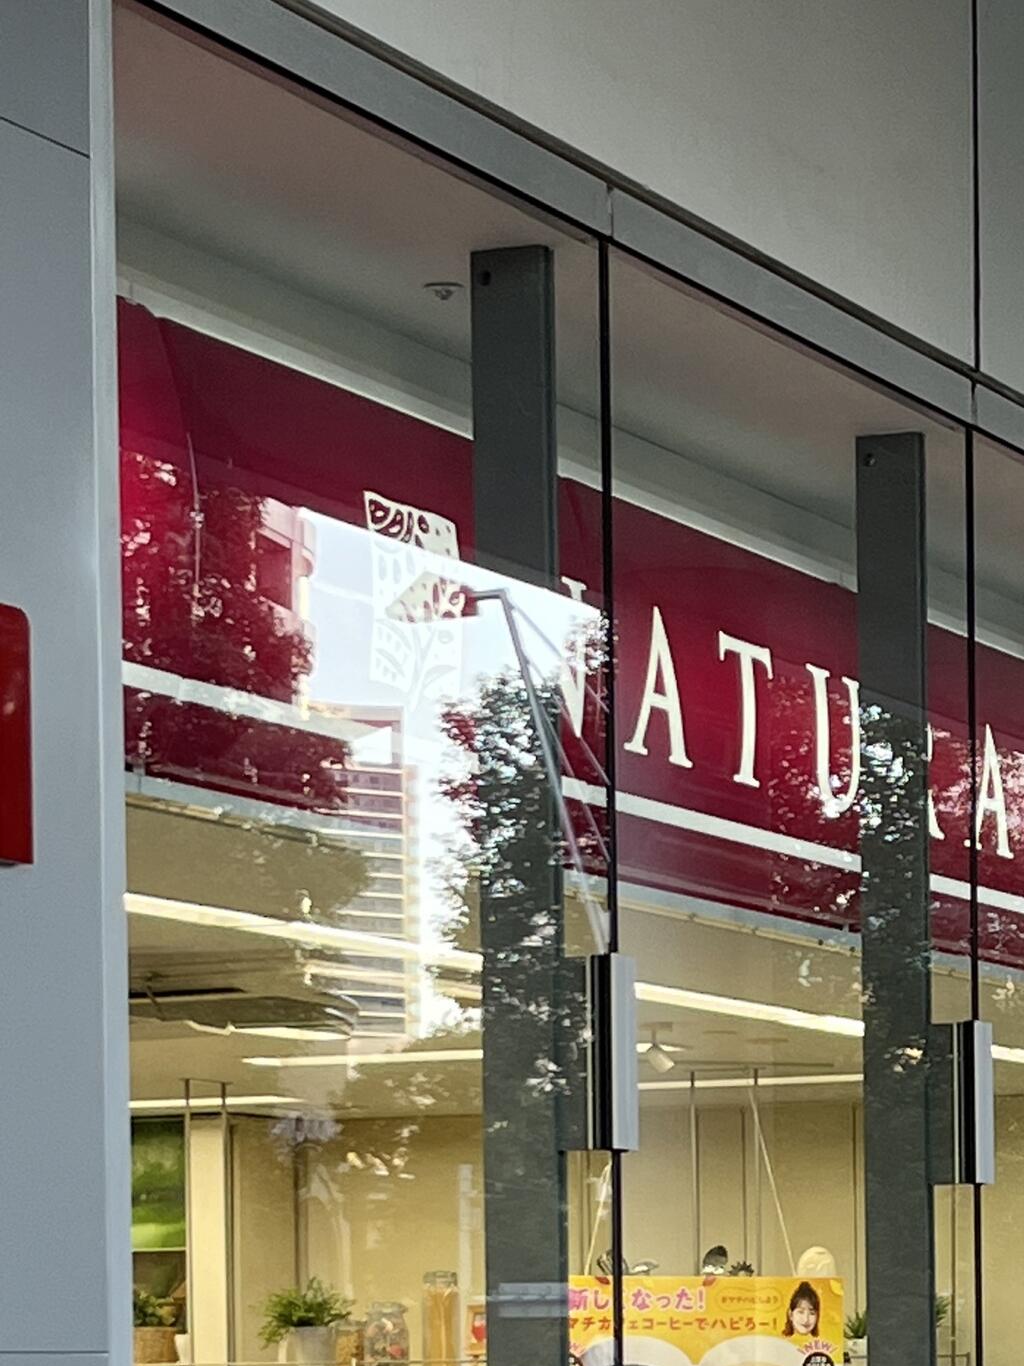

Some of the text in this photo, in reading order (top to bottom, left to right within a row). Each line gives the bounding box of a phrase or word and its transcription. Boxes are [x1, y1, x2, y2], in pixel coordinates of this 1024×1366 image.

[568, 1286, 706, 1312] 新しなった!
[569, 1315, 778, 1332] マチカェコーヒーでハピろー!
